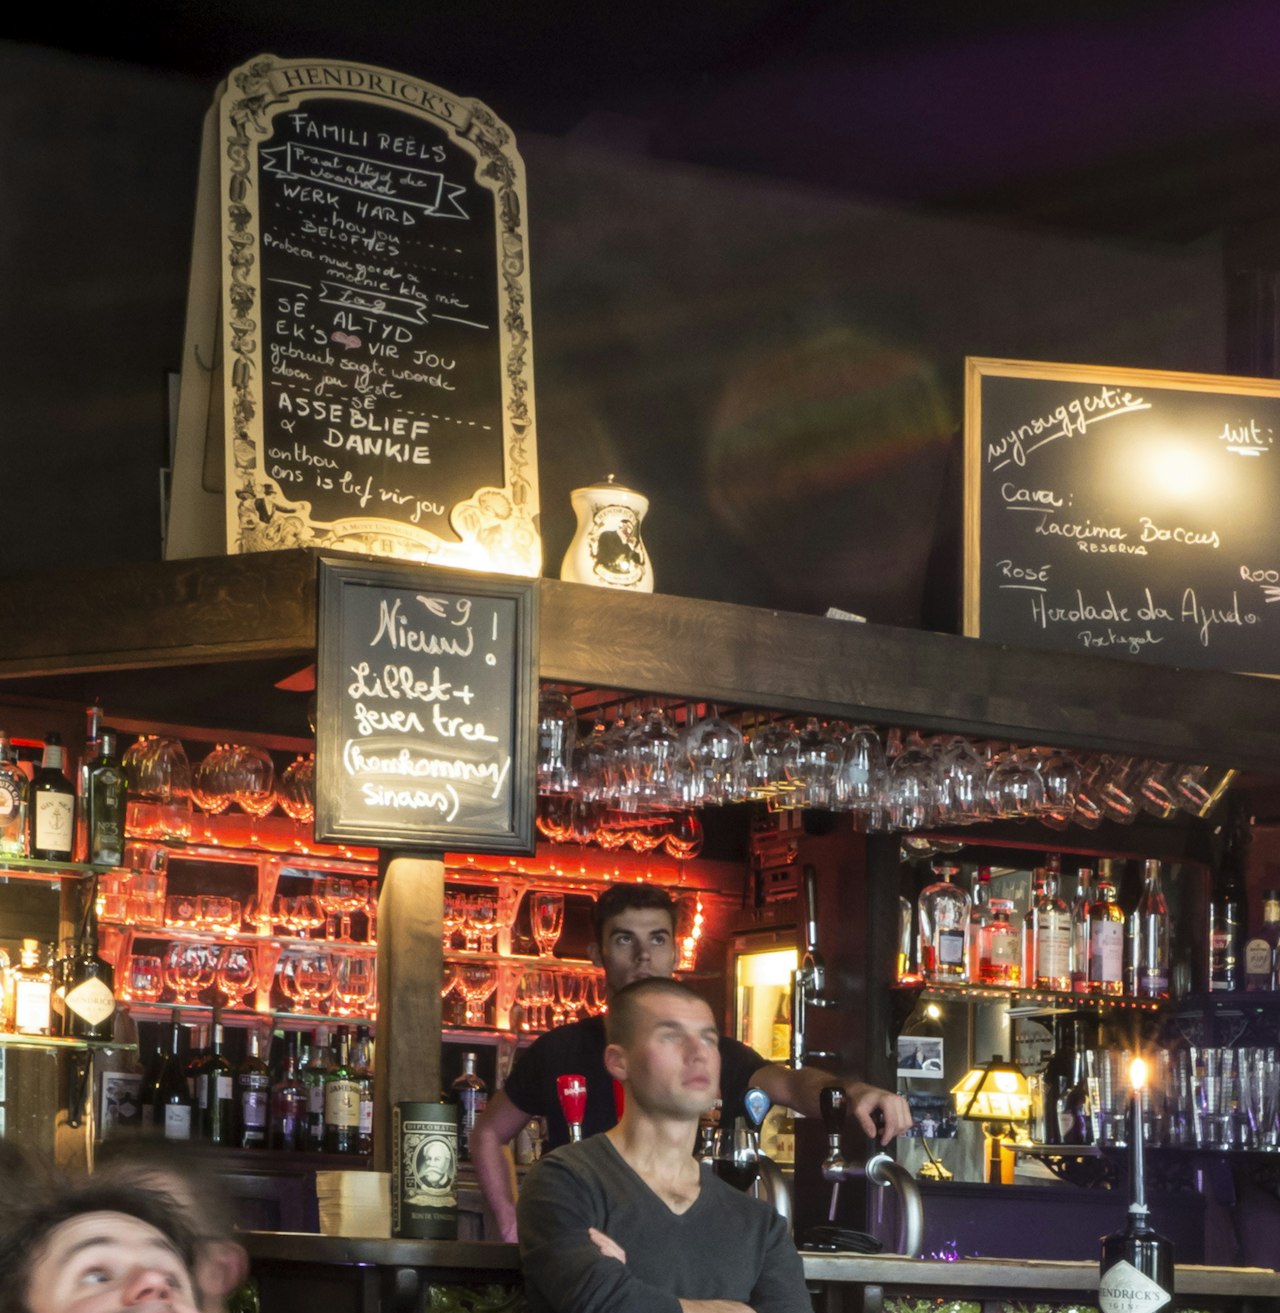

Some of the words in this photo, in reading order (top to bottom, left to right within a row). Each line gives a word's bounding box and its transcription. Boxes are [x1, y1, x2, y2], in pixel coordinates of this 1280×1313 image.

[282, 67, 456, 119] HENDRICK'S
[283, 183, 340, 209] WERK
[357, 200, 416, 226] HARD
[332, 211, 366, 235] hou
[278, 292, 310, 319] SÊ
[332, 310, 414, 343] ALTYD
[368, 341, 400, 360] VIR
[413, 349, 457, 372] JOU
[278, 392, 431, 441] ASSEBLIEF
[267, 443, 340, 470] onthou
[323, 428, 433, 465] DANKIE
[271, 465, 304, 483] ons
[315, 472, 334, 491] is
[410, 499, 446, 524] jou
[1000, 482, 1074, 507] Cava:
[1035, 513, 1128, 541] Lacrima
[1076, 540, 1149, 556] RESERVA
[995, 559, 1052, 582] Rosé
[1136, 587, 1175, 622] da
[347, 661, 452, 703] Lillet
[354, 702, 425, 736] fever
[432, 702, 500, 743] tree
